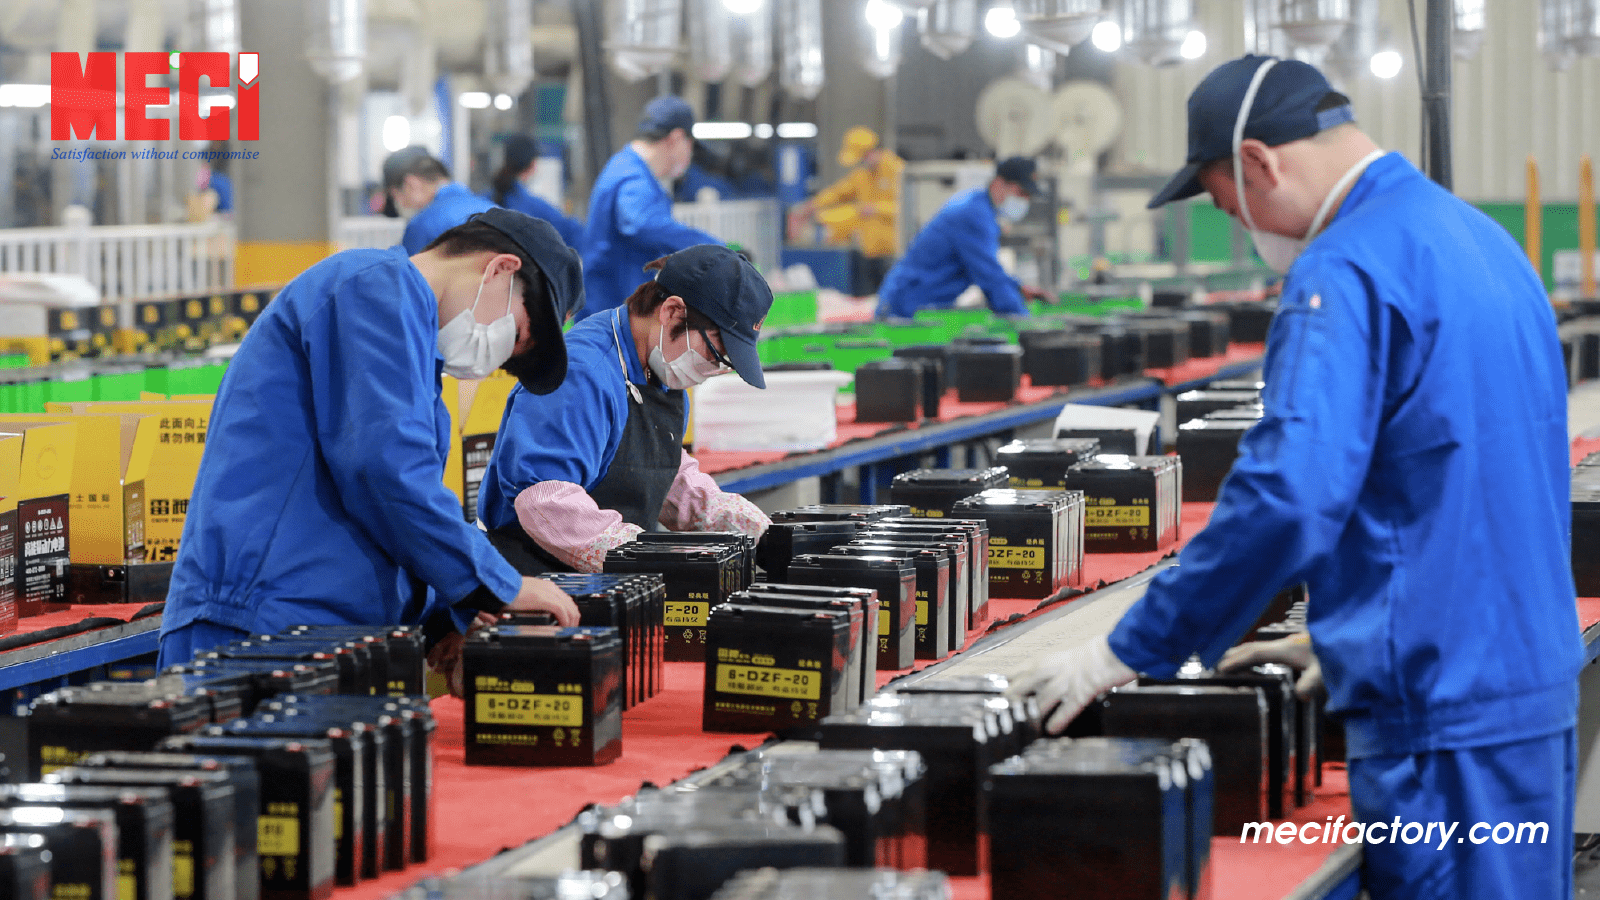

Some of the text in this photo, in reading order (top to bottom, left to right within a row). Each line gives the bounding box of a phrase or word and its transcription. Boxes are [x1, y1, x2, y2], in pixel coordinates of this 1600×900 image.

[160, 417, 207, 429] 此面向上
[160, 432, 206, 444] 请勿倒置
[728, 669, 809, 686] 6-DZF-20
